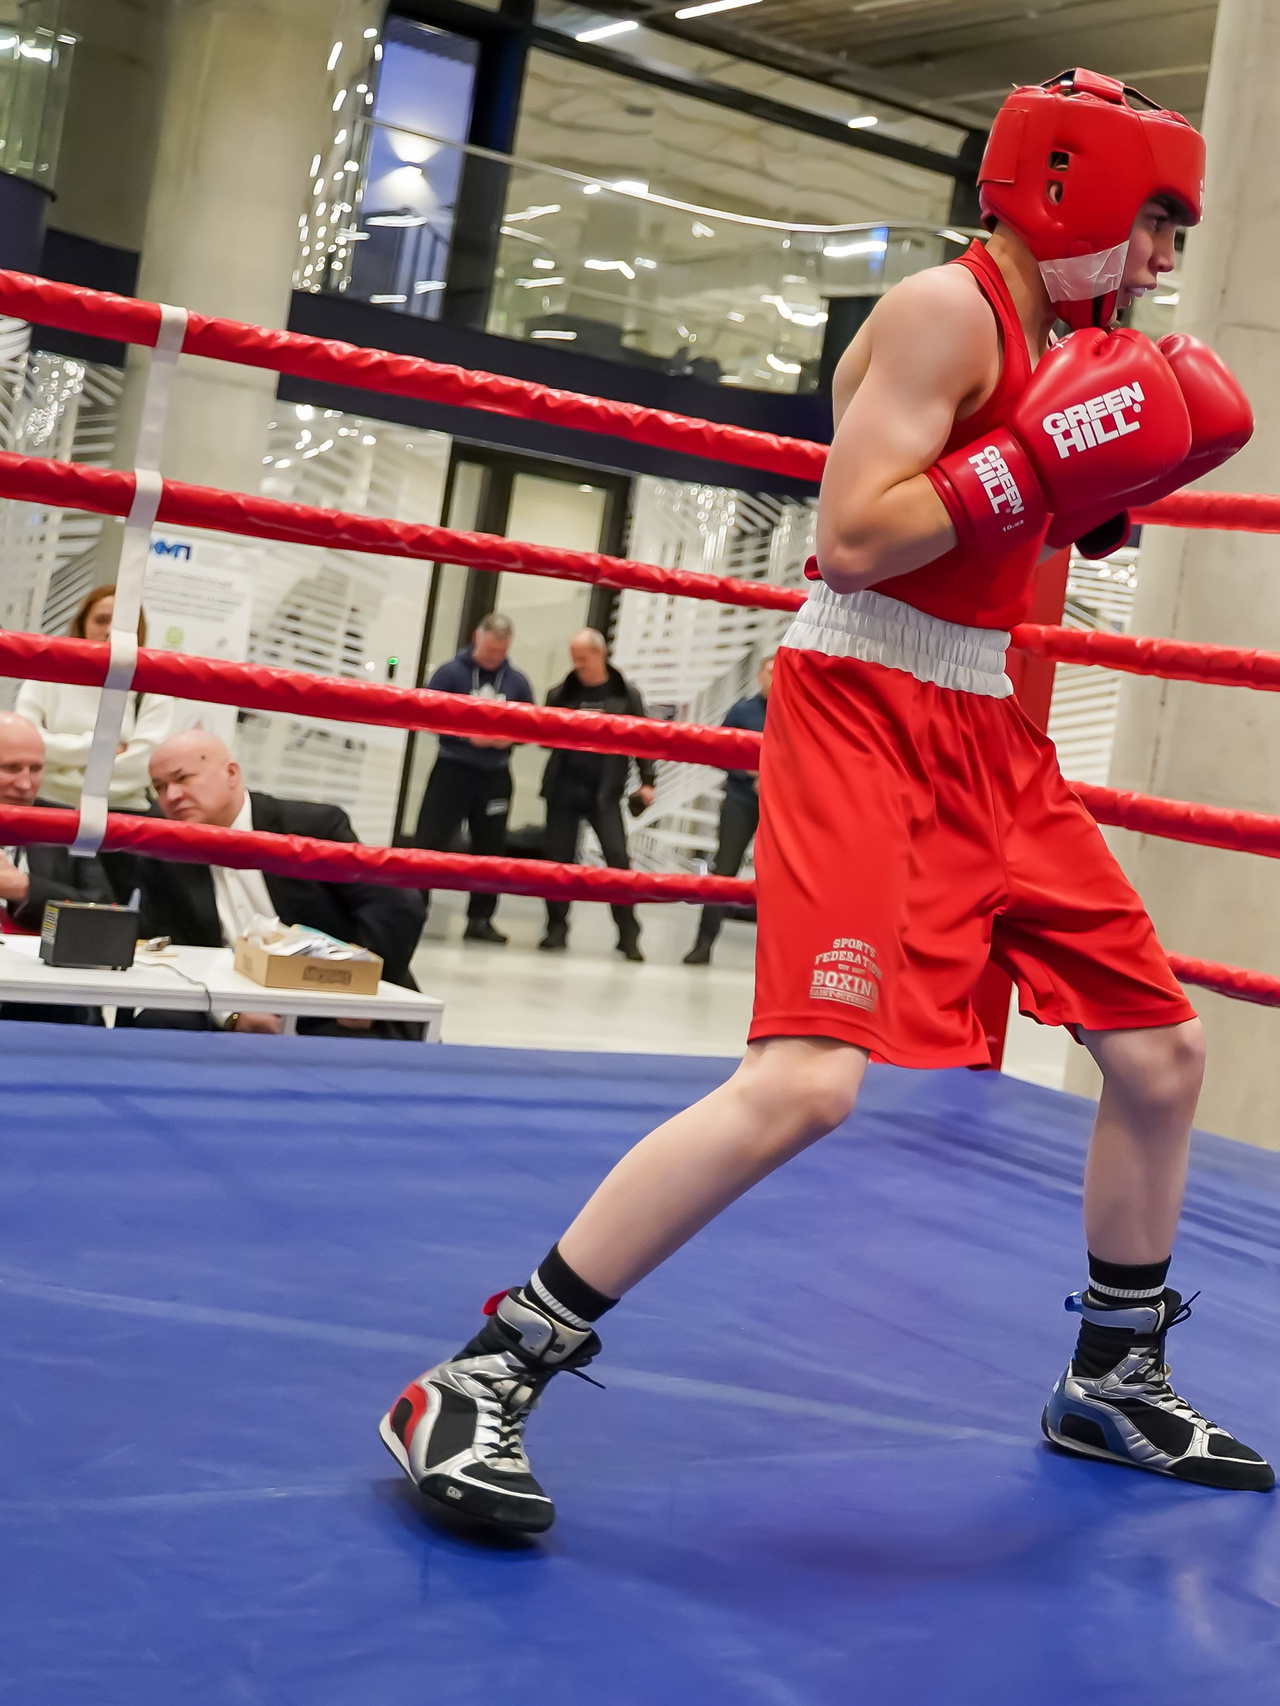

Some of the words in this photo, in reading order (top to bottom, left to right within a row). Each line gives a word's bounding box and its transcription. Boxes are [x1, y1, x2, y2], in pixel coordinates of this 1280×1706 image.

[1042, 381, 1145, 436] GREEN
[1053, 410, 1141, 459] HILL
[968, 452, 1000, 514] HILL
[983, 445, 1025, 515] GREEN
[833, 939, 875, 957] SPORTS
